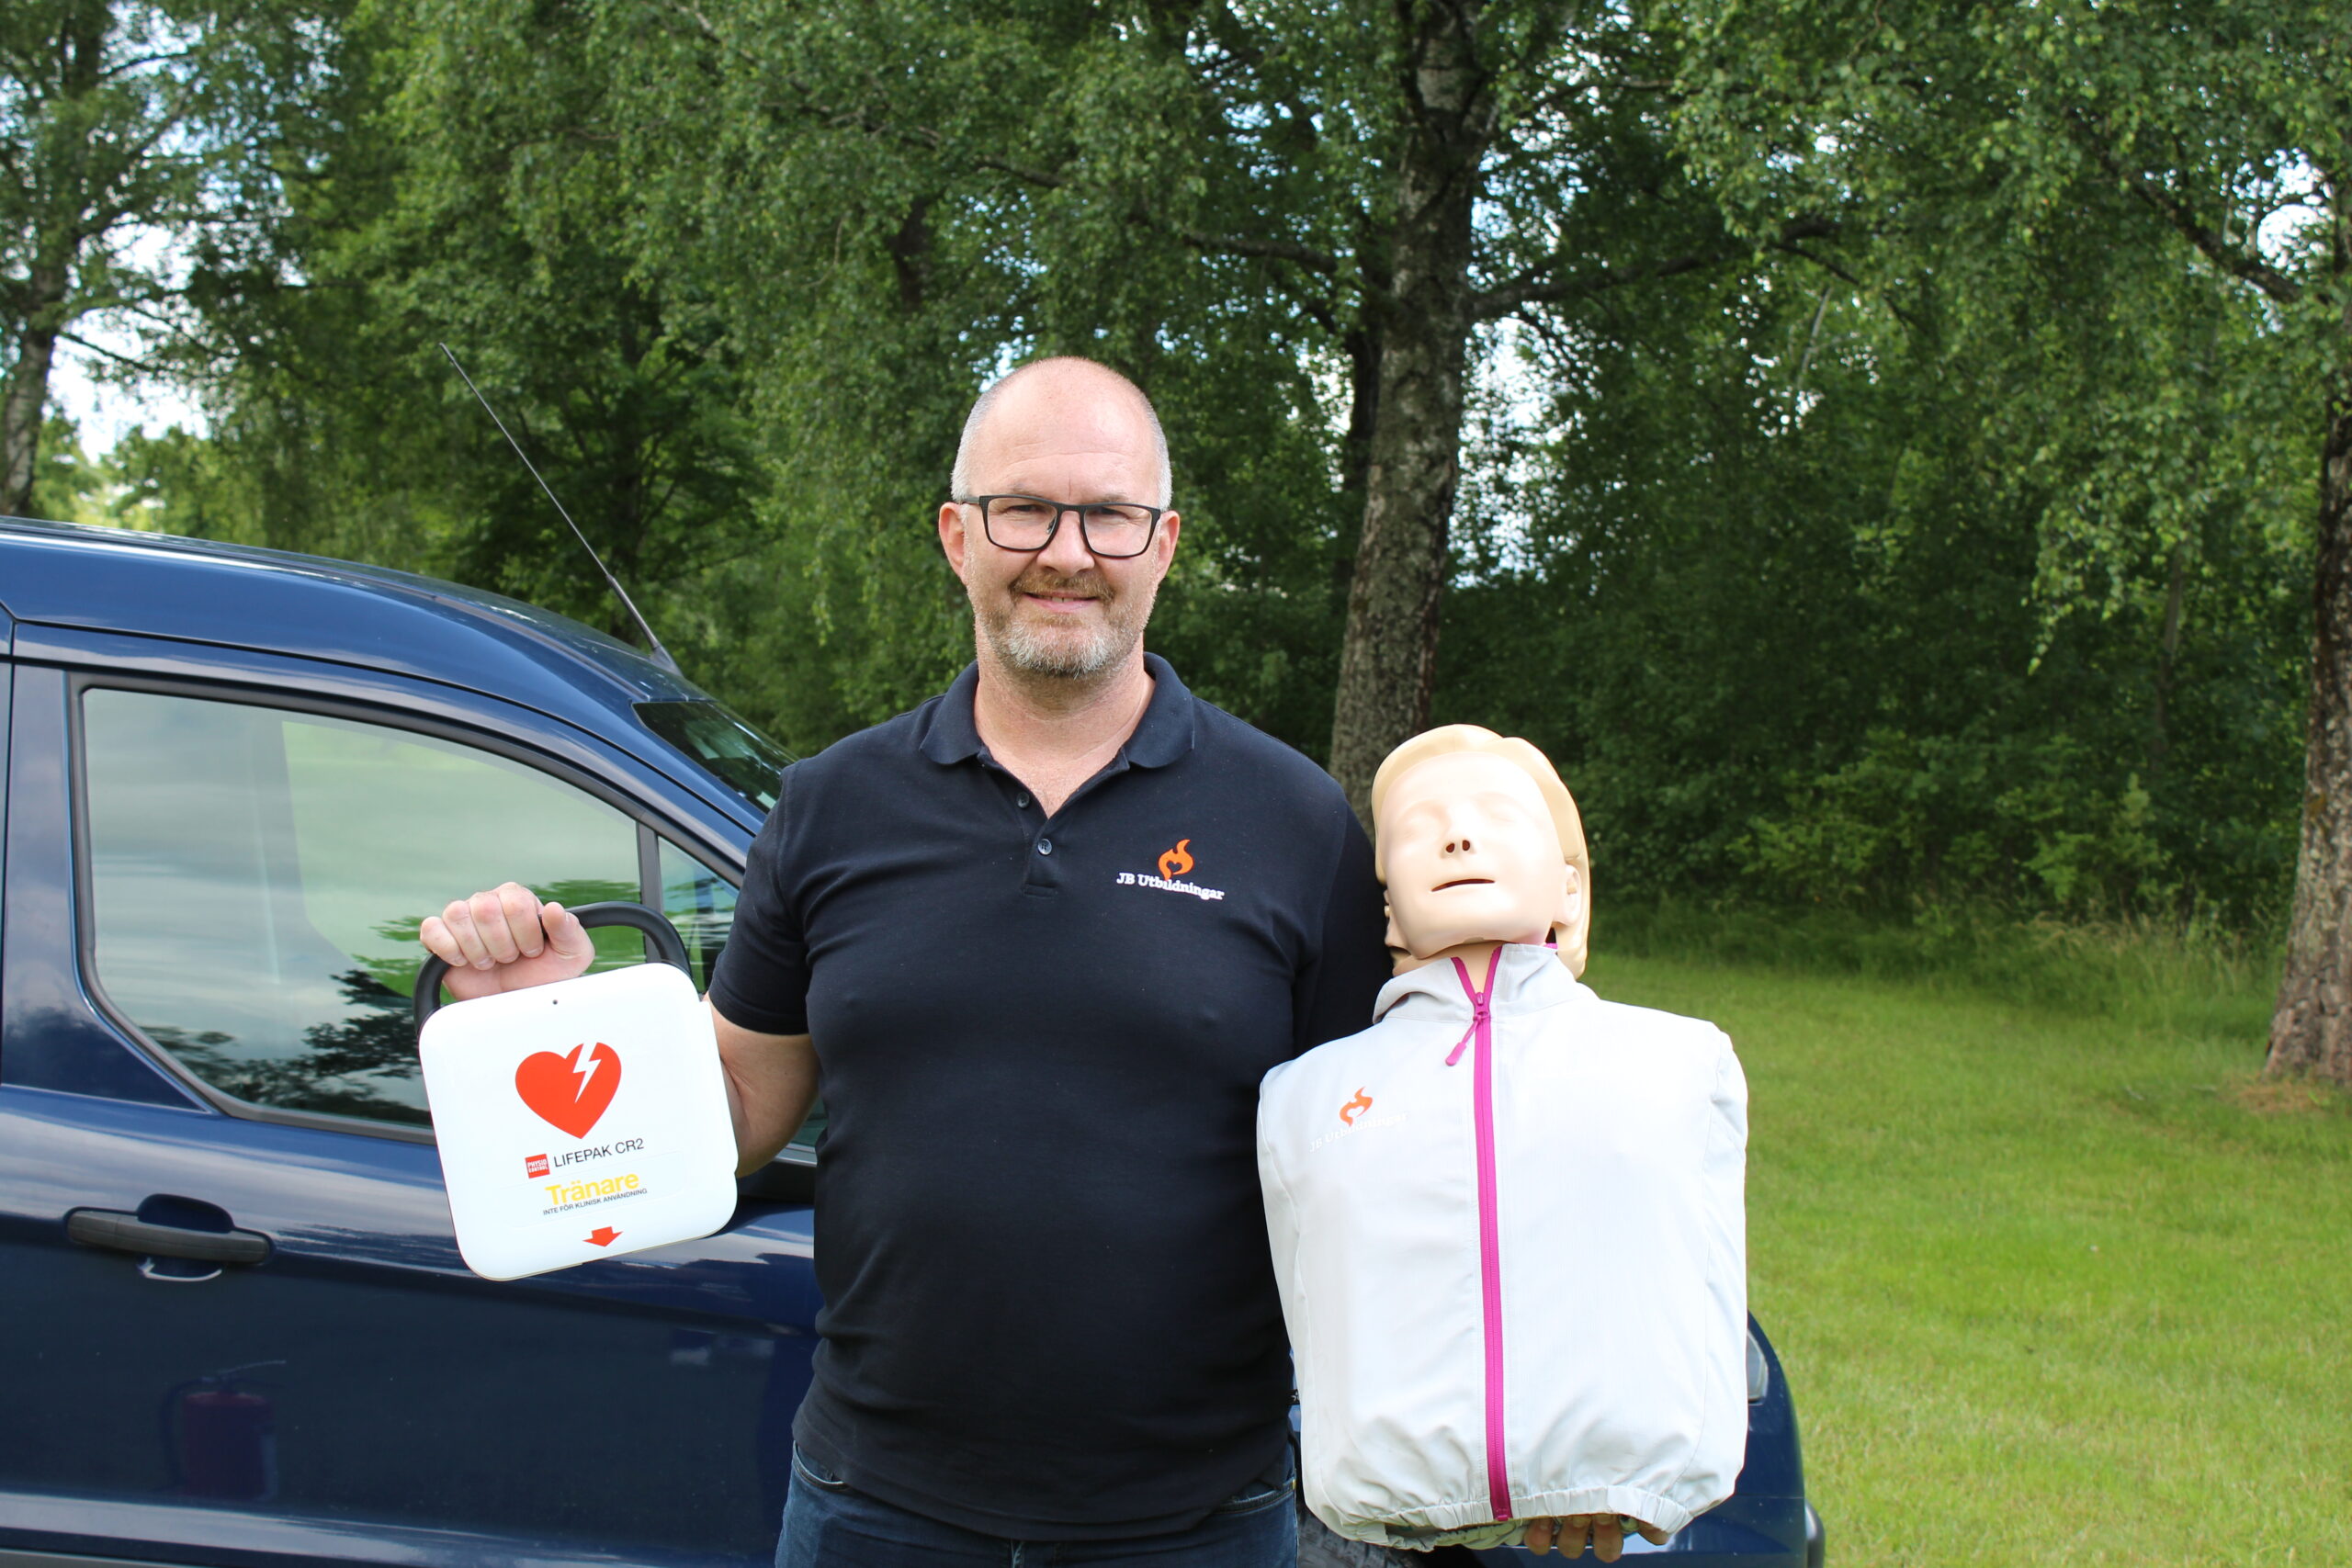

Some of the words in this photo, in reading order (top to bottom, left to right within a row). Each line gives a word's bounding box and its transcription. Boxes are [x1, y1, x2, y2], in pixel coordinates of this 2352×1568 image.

[1116, 872, 1136, 885] JB
[1137, 874, 1225, 900] Utbildningar
[554, 1145, 613, 1168] LIFEPAK
[615, 1138, 645, 1155] CR2
[543, 1207, 559, 1215] INTE
[560, 1202, 574, 1213] FÖR
[575, 1198, 603, 1209] KLINISK
[603, 1188, 648, 1203] ANVÄNDNING
[545, 1173, 639, 1205] Tränare
